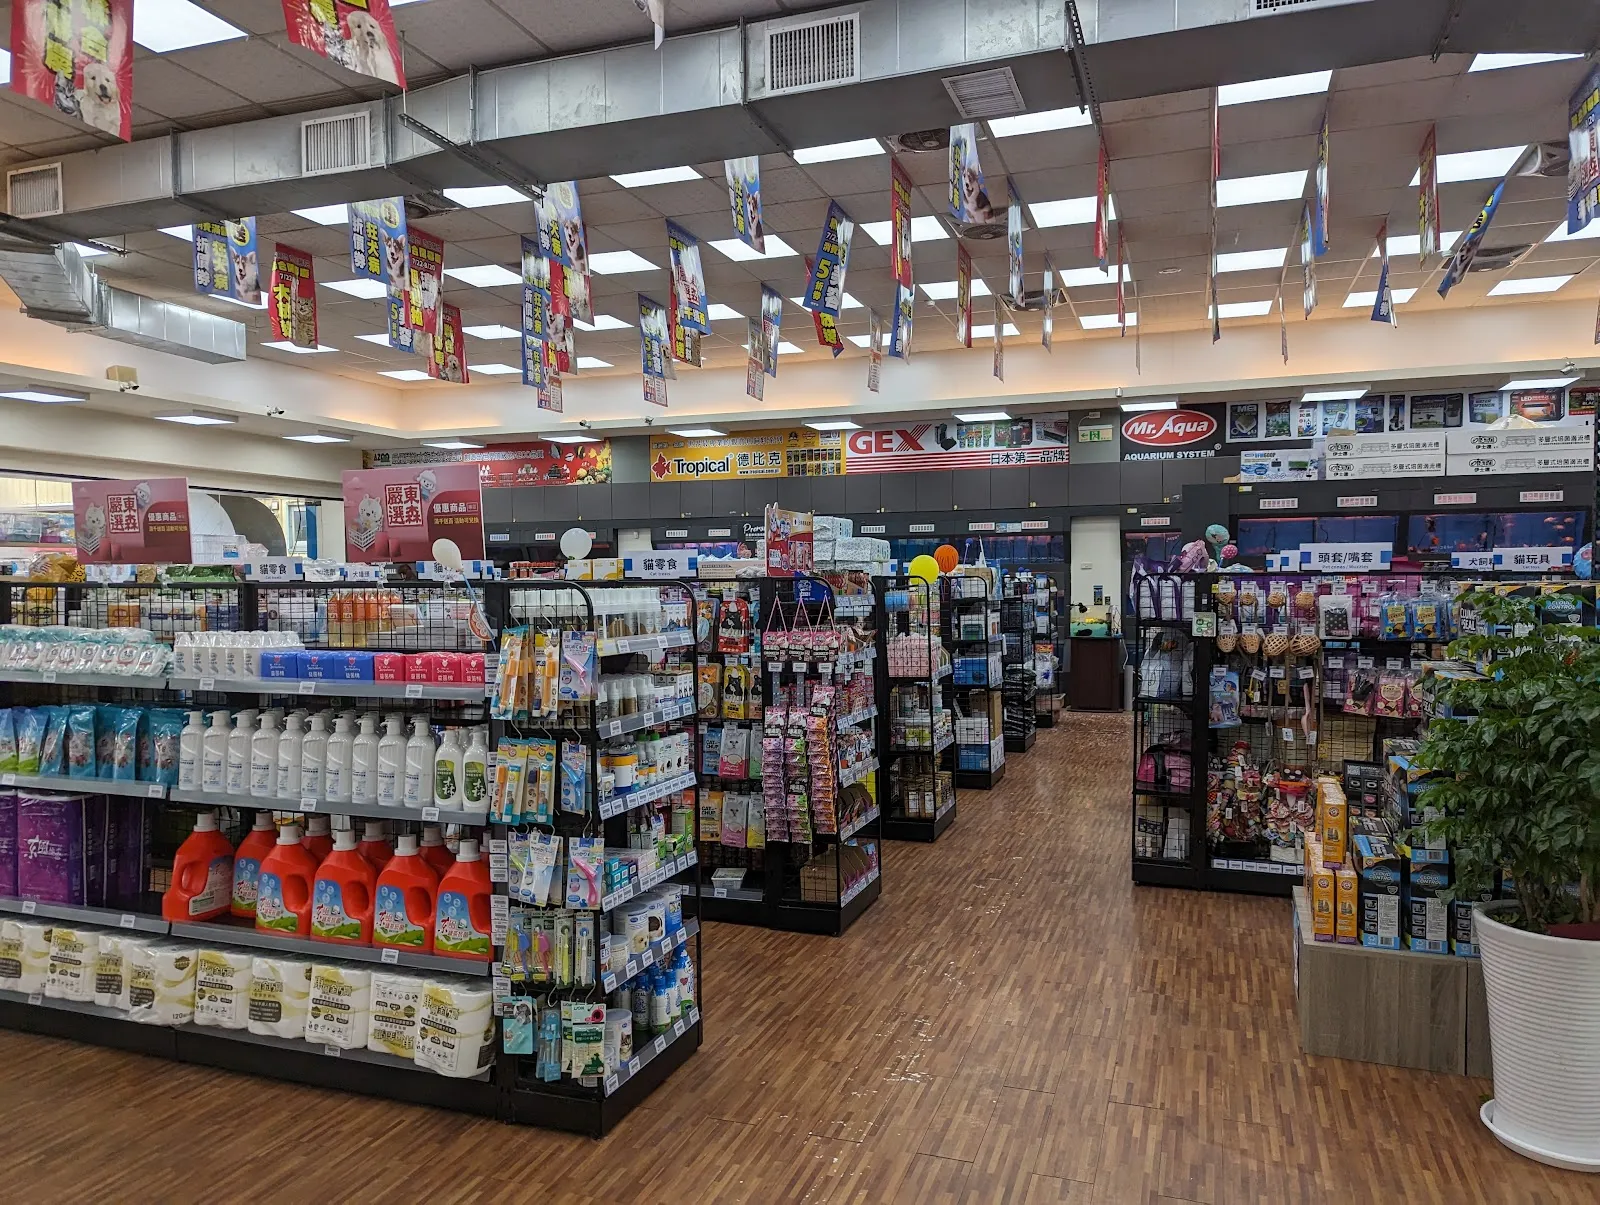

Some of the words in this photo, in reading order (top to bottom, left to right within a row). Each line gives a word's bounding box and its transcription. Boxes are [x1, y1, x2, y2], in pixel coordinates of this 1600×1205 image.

[1126, 421, 1157, 436] Mr.
[1150, 414, 1209, 438] Aqua
[848, 423, 932, 455] GEX
[736, 451, 782, 467] 德比克
[989, 450, 1066, 465] 日本第一品牌
[1124, 450, 1176, 461] AQUARIUM
[1176, 449, 1215, 460] SYSTEM
[673, 454, 730, 476] Tropical
[642, 557, 677, 572] 貓零食
[1318, 551, 1373, 563] 頭套/嘴套
[1513, 554, 1551, 565] 貓玩具
[259, 563, 287, 575] 貓零食
